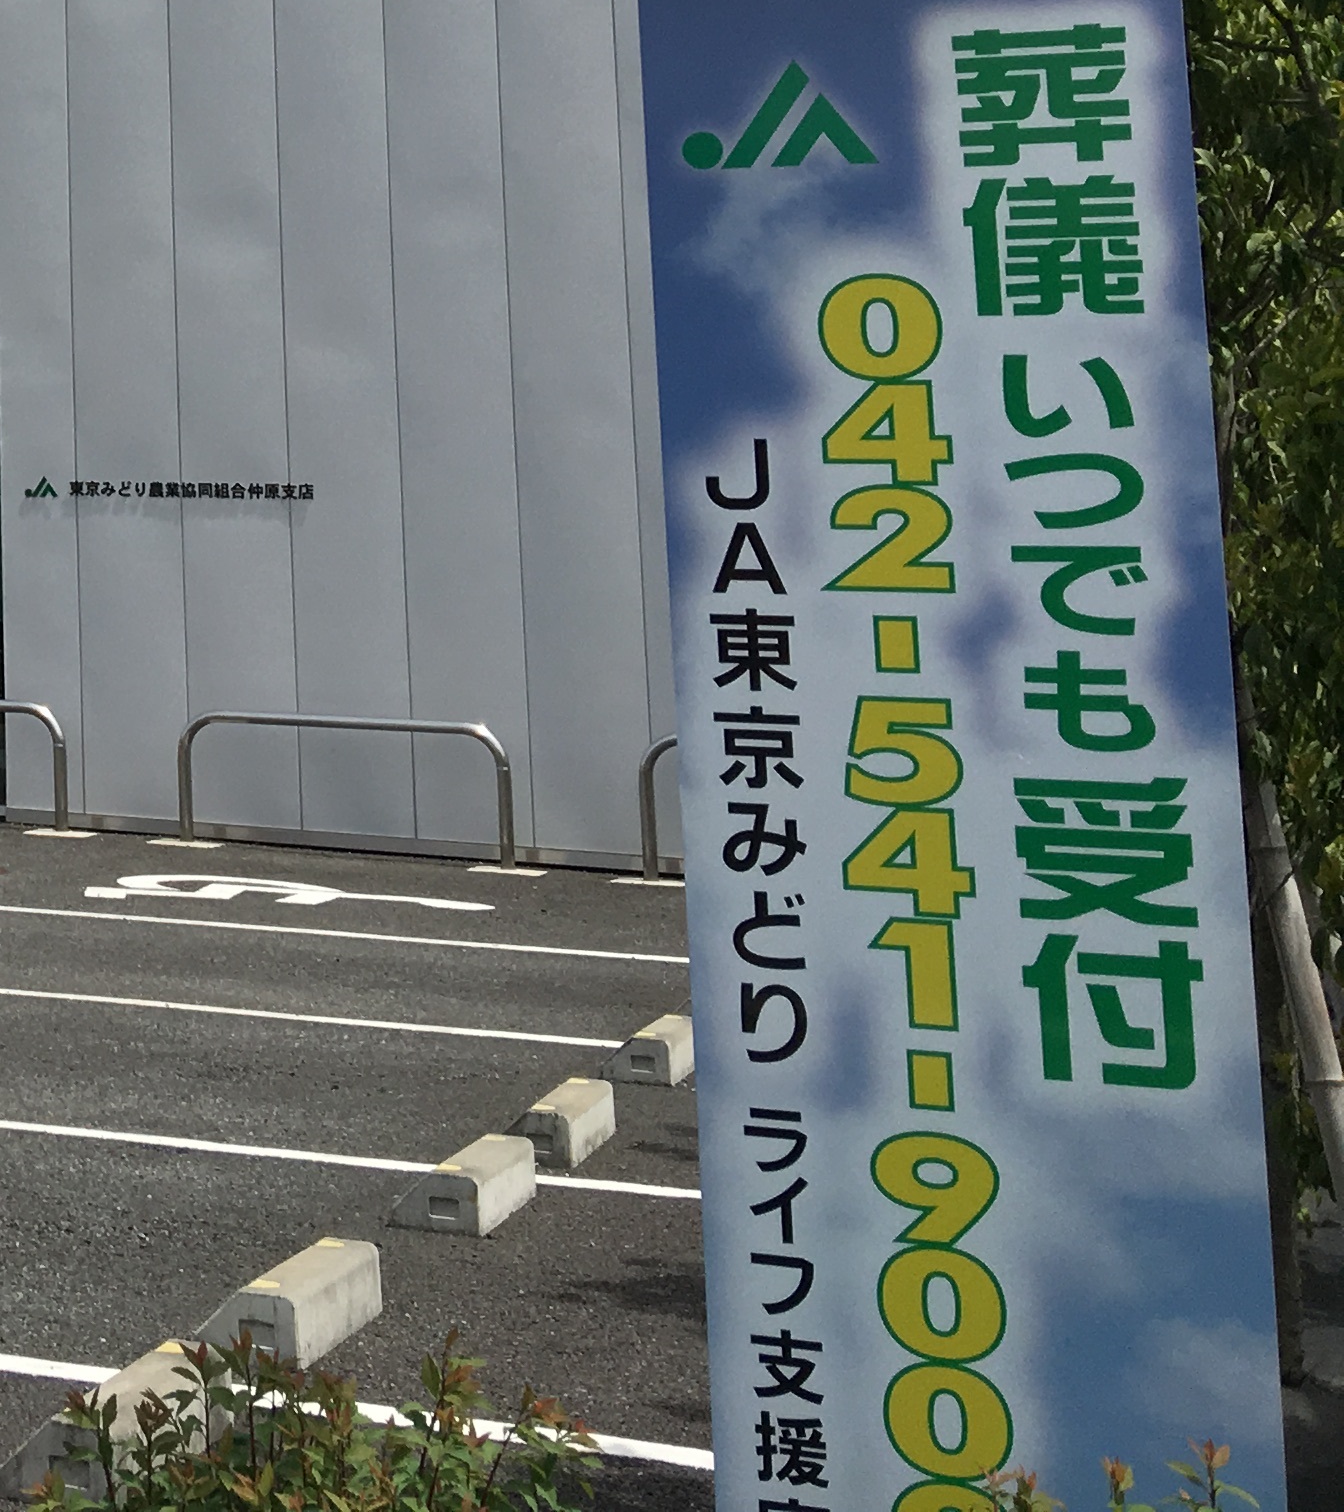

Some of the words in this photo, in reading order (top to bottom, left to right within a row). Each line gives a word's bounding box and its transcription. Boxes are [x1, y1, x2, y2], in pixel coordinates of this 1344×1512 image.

[69, 481, 314, 500] 東京みどり農業協同組合仲原支店
[952, 23, 1204, 1090] 葬儀いつでも受付
[817, 272, 1015, 1512] 042-541-900
[743, 1107, 831, 1512] ライフ支援
